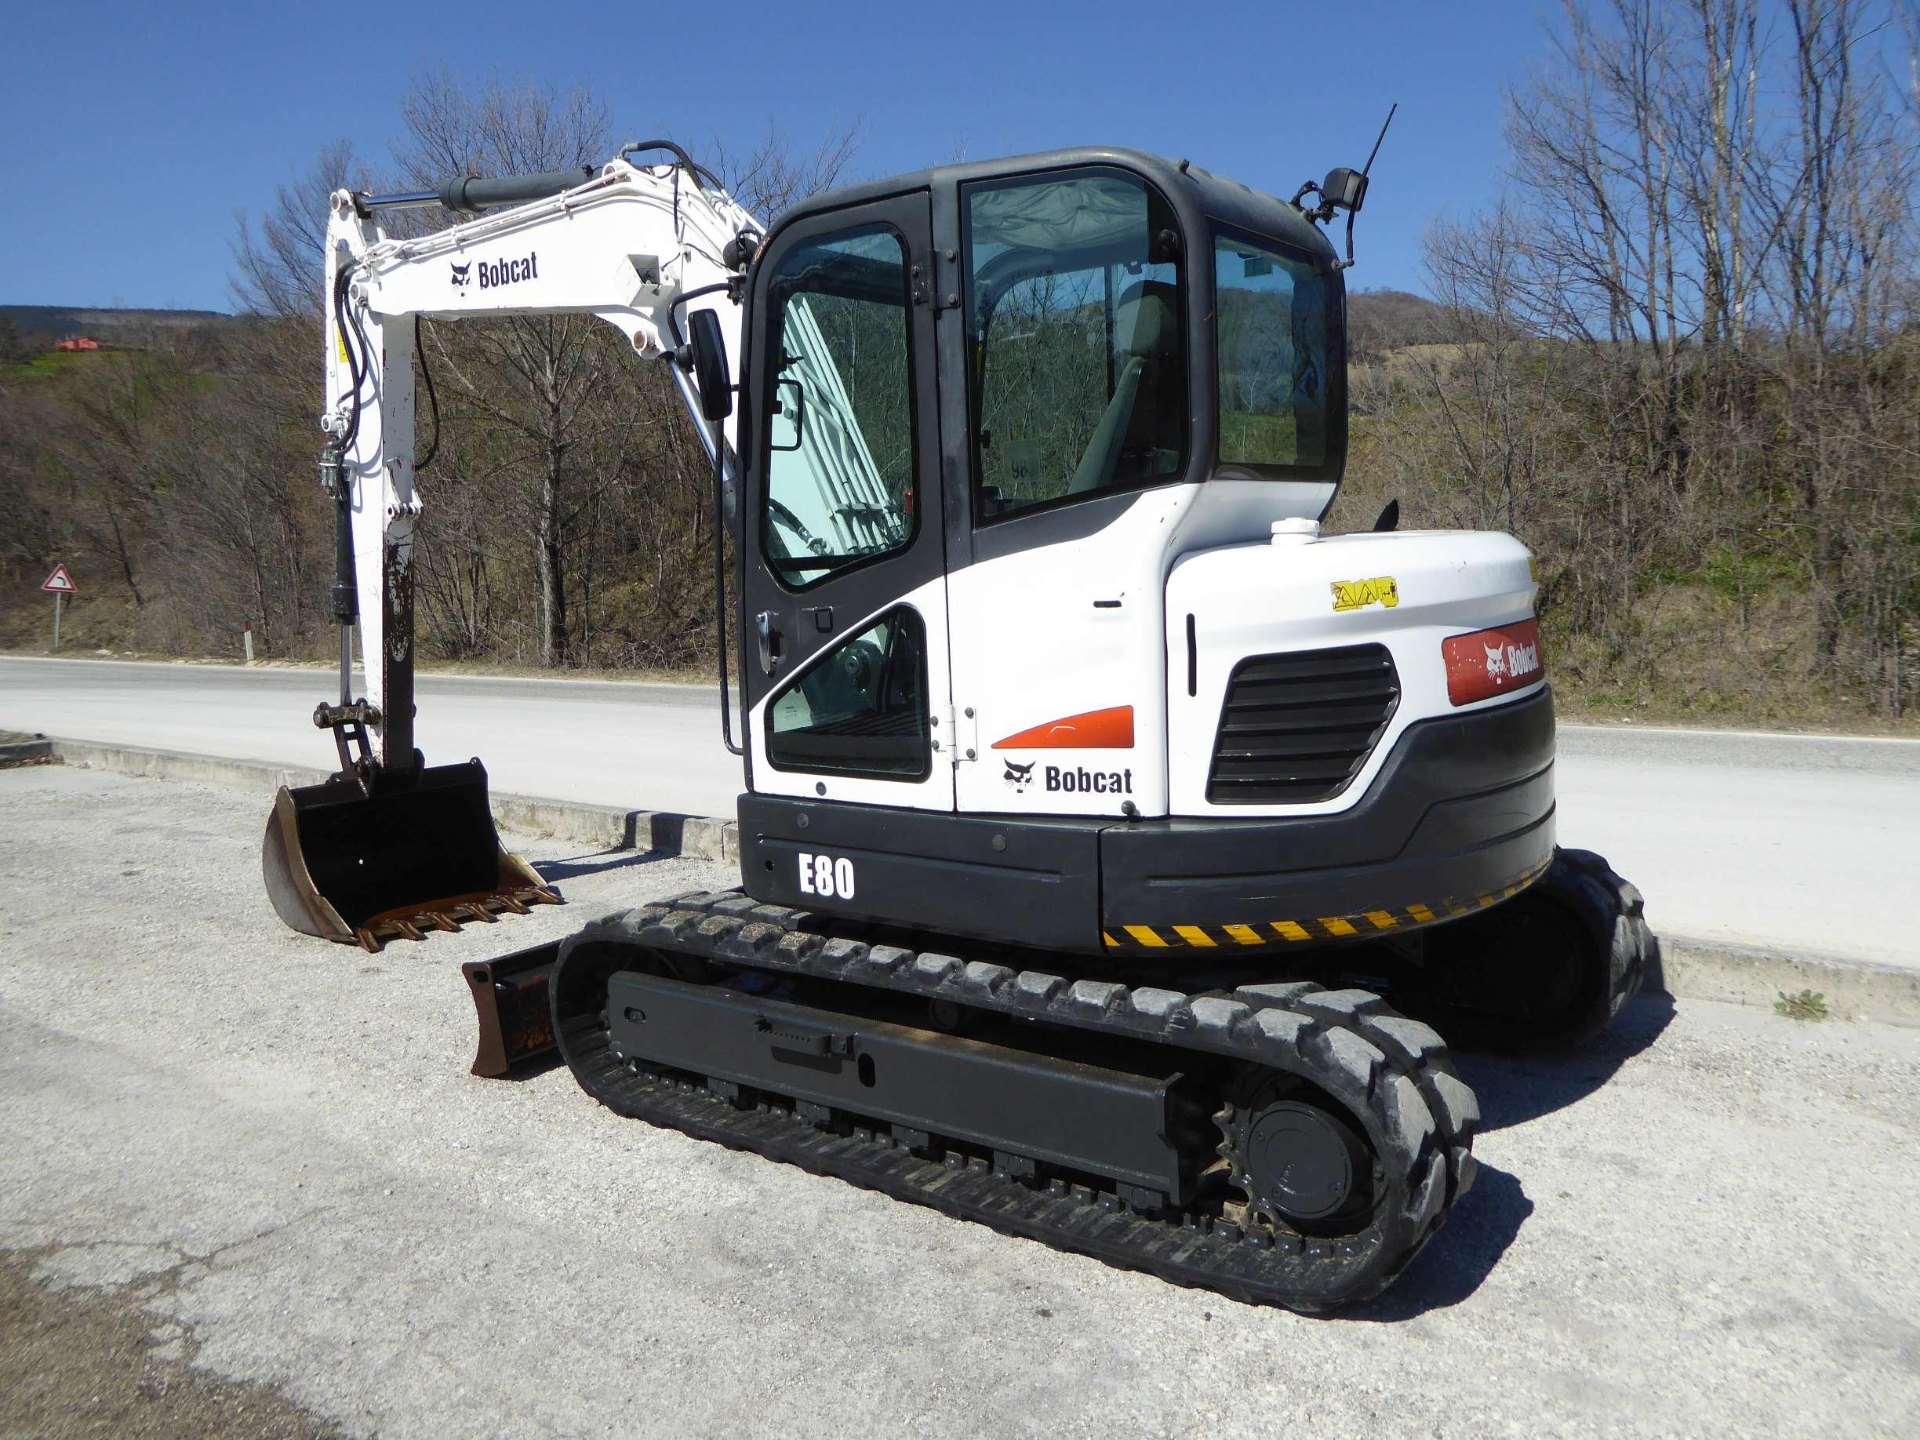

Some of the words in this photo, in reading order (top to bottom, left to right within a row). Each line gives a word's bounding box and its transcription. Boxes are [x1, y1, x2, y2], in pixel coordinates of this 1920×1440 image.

[478, 251, 538, 290] Bobcat
[1507, 640, 1539, 677] Bobcat
[1045, 765, 1132, 793] Bobcat
[798, 852, 855, 900] E80
